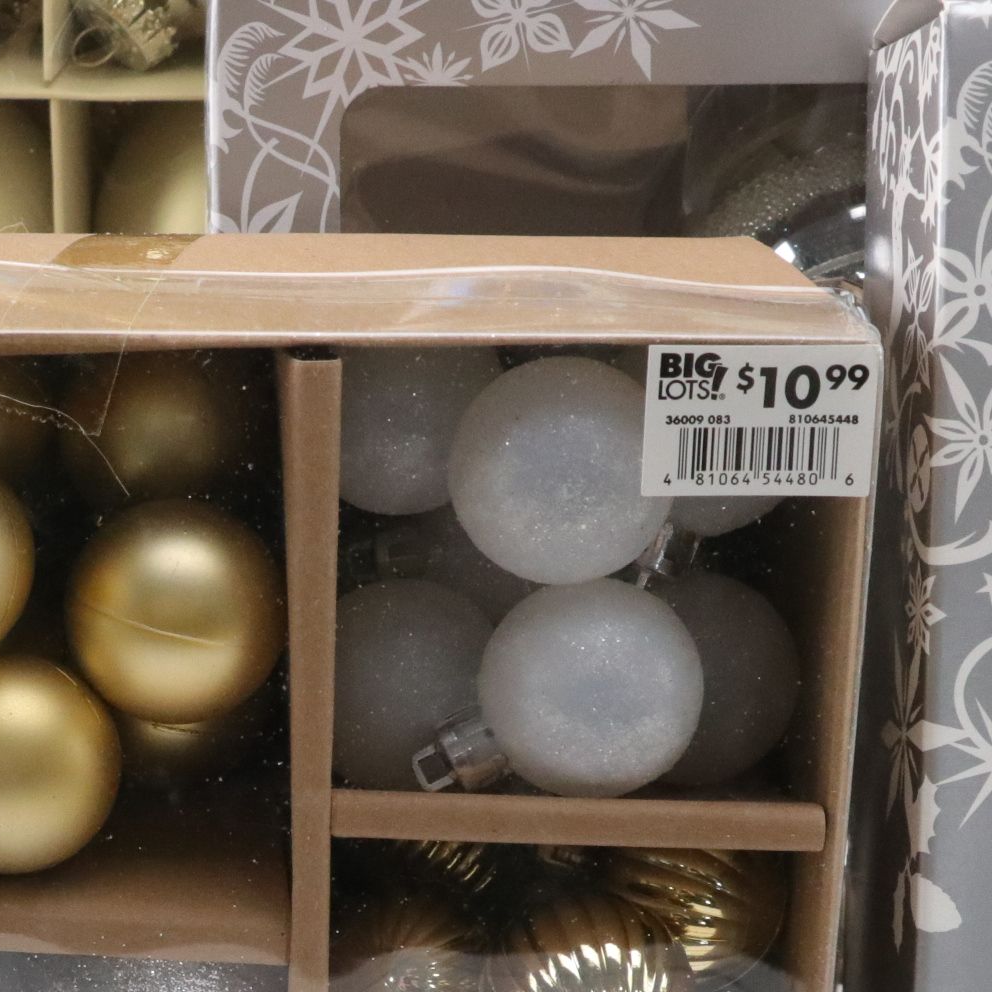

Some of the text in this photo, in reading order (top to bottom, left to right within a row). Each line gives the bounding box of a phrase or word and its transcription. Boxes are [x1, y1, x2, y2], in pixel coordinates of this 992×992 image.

[659, 352, 722, 379] BIG
[665, 415, 859, 426] 36009 083 810645448
[663, 473, 672, 486] 4
[844, 473, 854, 486] 6
